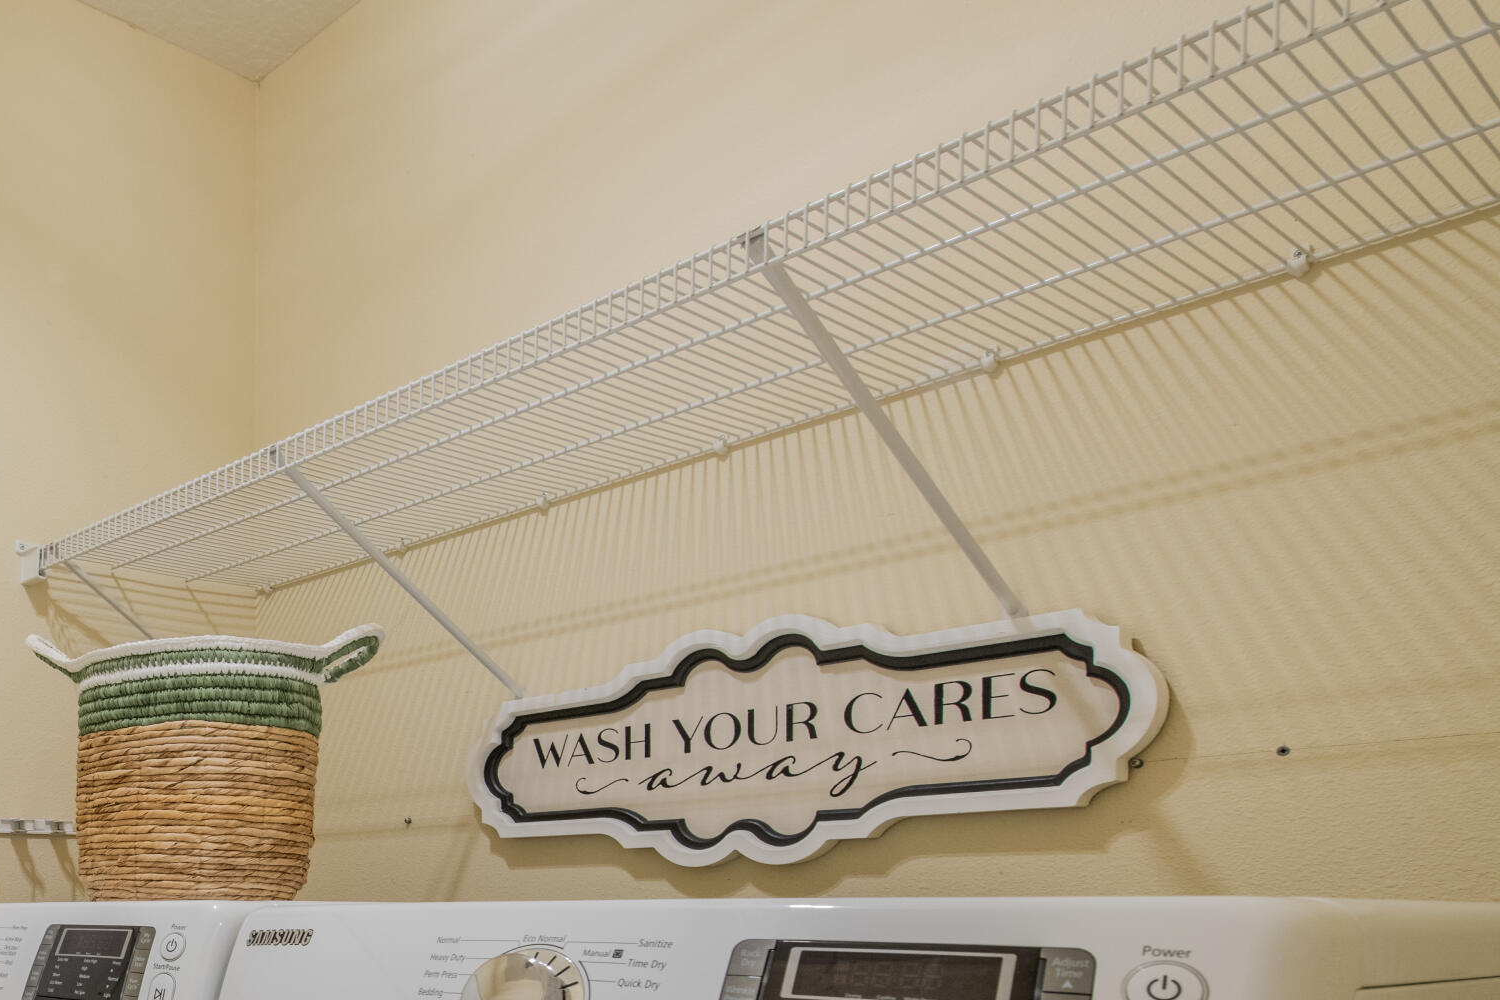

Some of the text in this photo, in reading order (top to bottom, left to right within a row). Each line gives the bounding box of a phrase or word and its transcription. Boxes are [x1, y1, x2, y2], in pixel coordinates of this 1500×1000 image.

[533, 668, 1059, 768] WASH YOUR CARES
[640, 749, 877, 798] away
[246, 928, 315, 946] SAMSUNG
[437, 936, 460, 944] Normal
[523, 935, 567, 943] Eco Normal
[638, 939, 675, 948] Sanitize
[582, 949, 611, 958] Manual
[1142, 945, 1194, 959] Power
[430, 954, 465, 962] Heavy Duty
[1052, 957, 1090, 969] Adjust
[627, 959, 668, 971] Time Dry
[1054, 968, 1084, 979] Time
[617, 979, 661, 991] Quick Dry
[417, 988, 444, 998] Bedding
